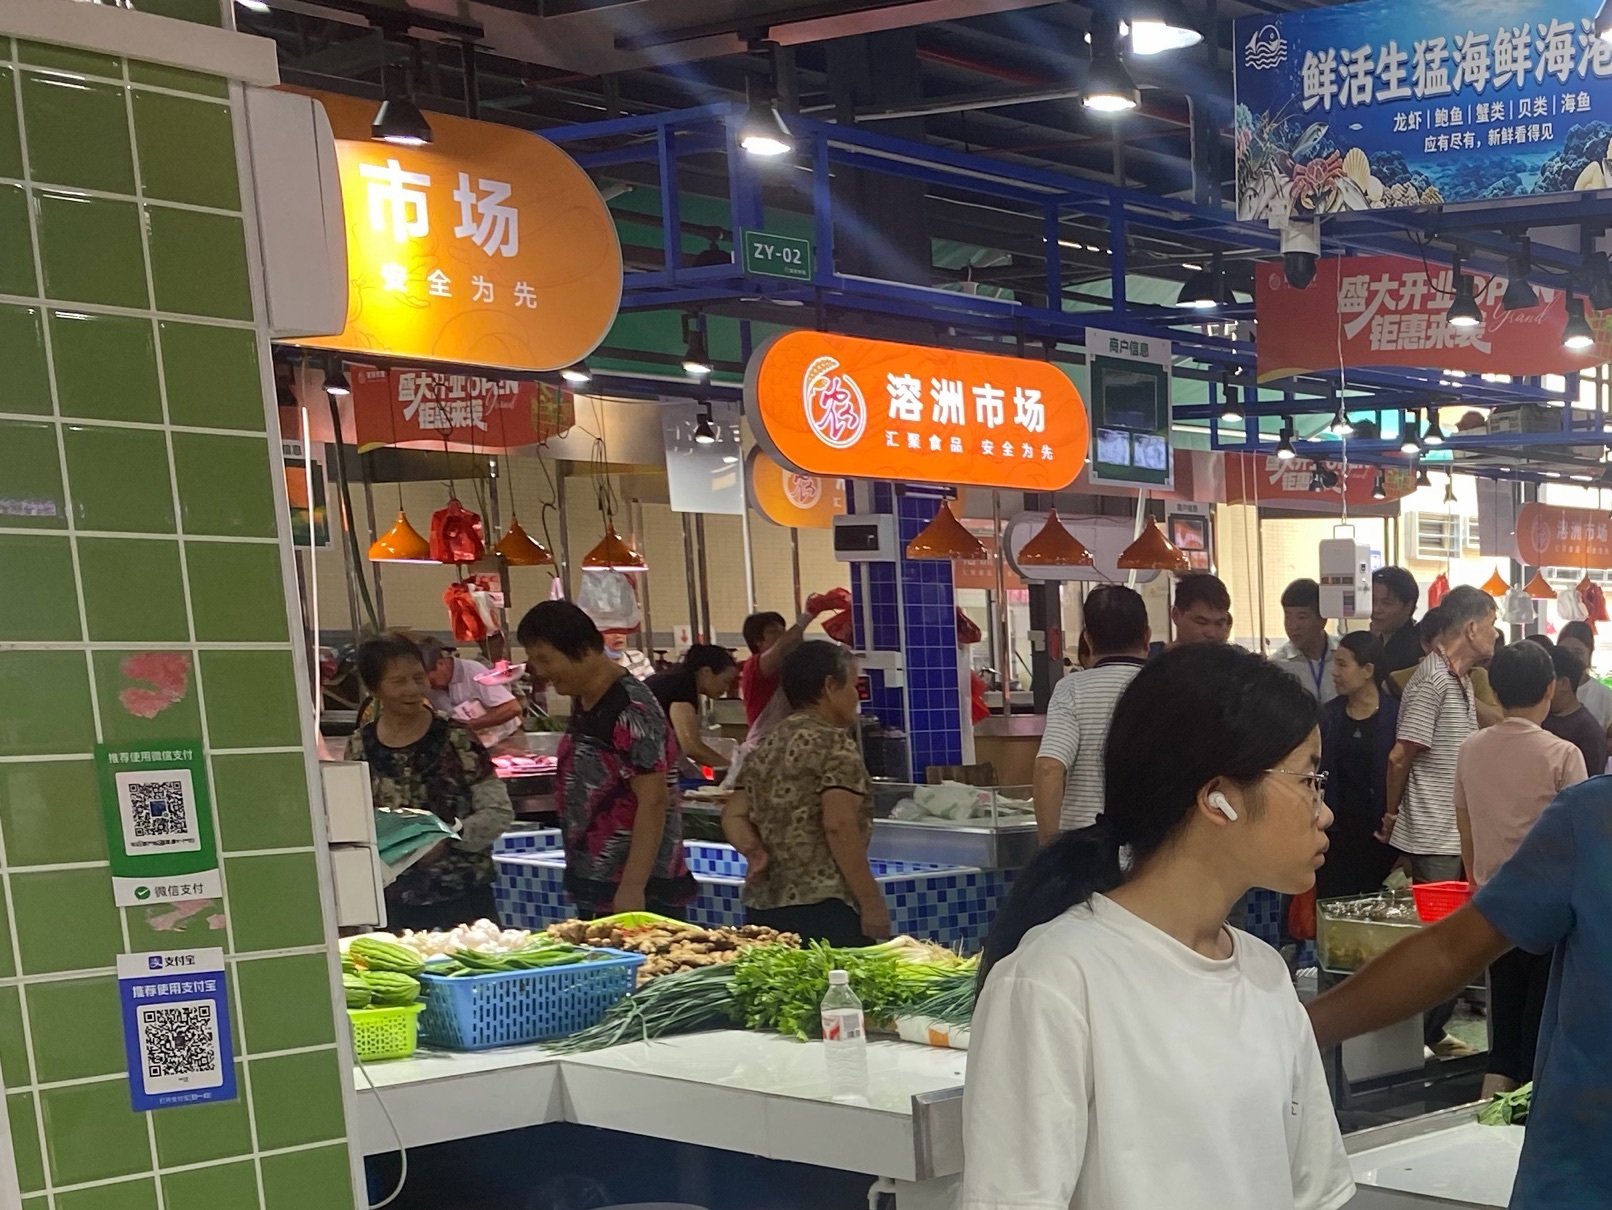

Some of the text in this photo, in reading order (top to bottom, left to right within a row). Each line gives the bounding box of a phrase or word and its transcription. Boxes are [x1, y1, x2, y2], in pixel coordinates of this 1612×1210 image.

[359, 159, 519, 257] 市场
[753, 243, 802, 264] ZY-02
[381, 262, 537, 309] 安全为先
[1109, 337, 1150, 357] 商户信息
[886, 373, 1045, 433] 溶洲市场
[886, 431, 1054, 461] 汇聚食品 安全为先
[108, 749, 193, 763] 推荐使用微信支付
[155, 883, 203, 897] 微信支付
[164, 955, 195, 967] 支付宝
[132, 980, 217, 998] 推荐使用支付宝
